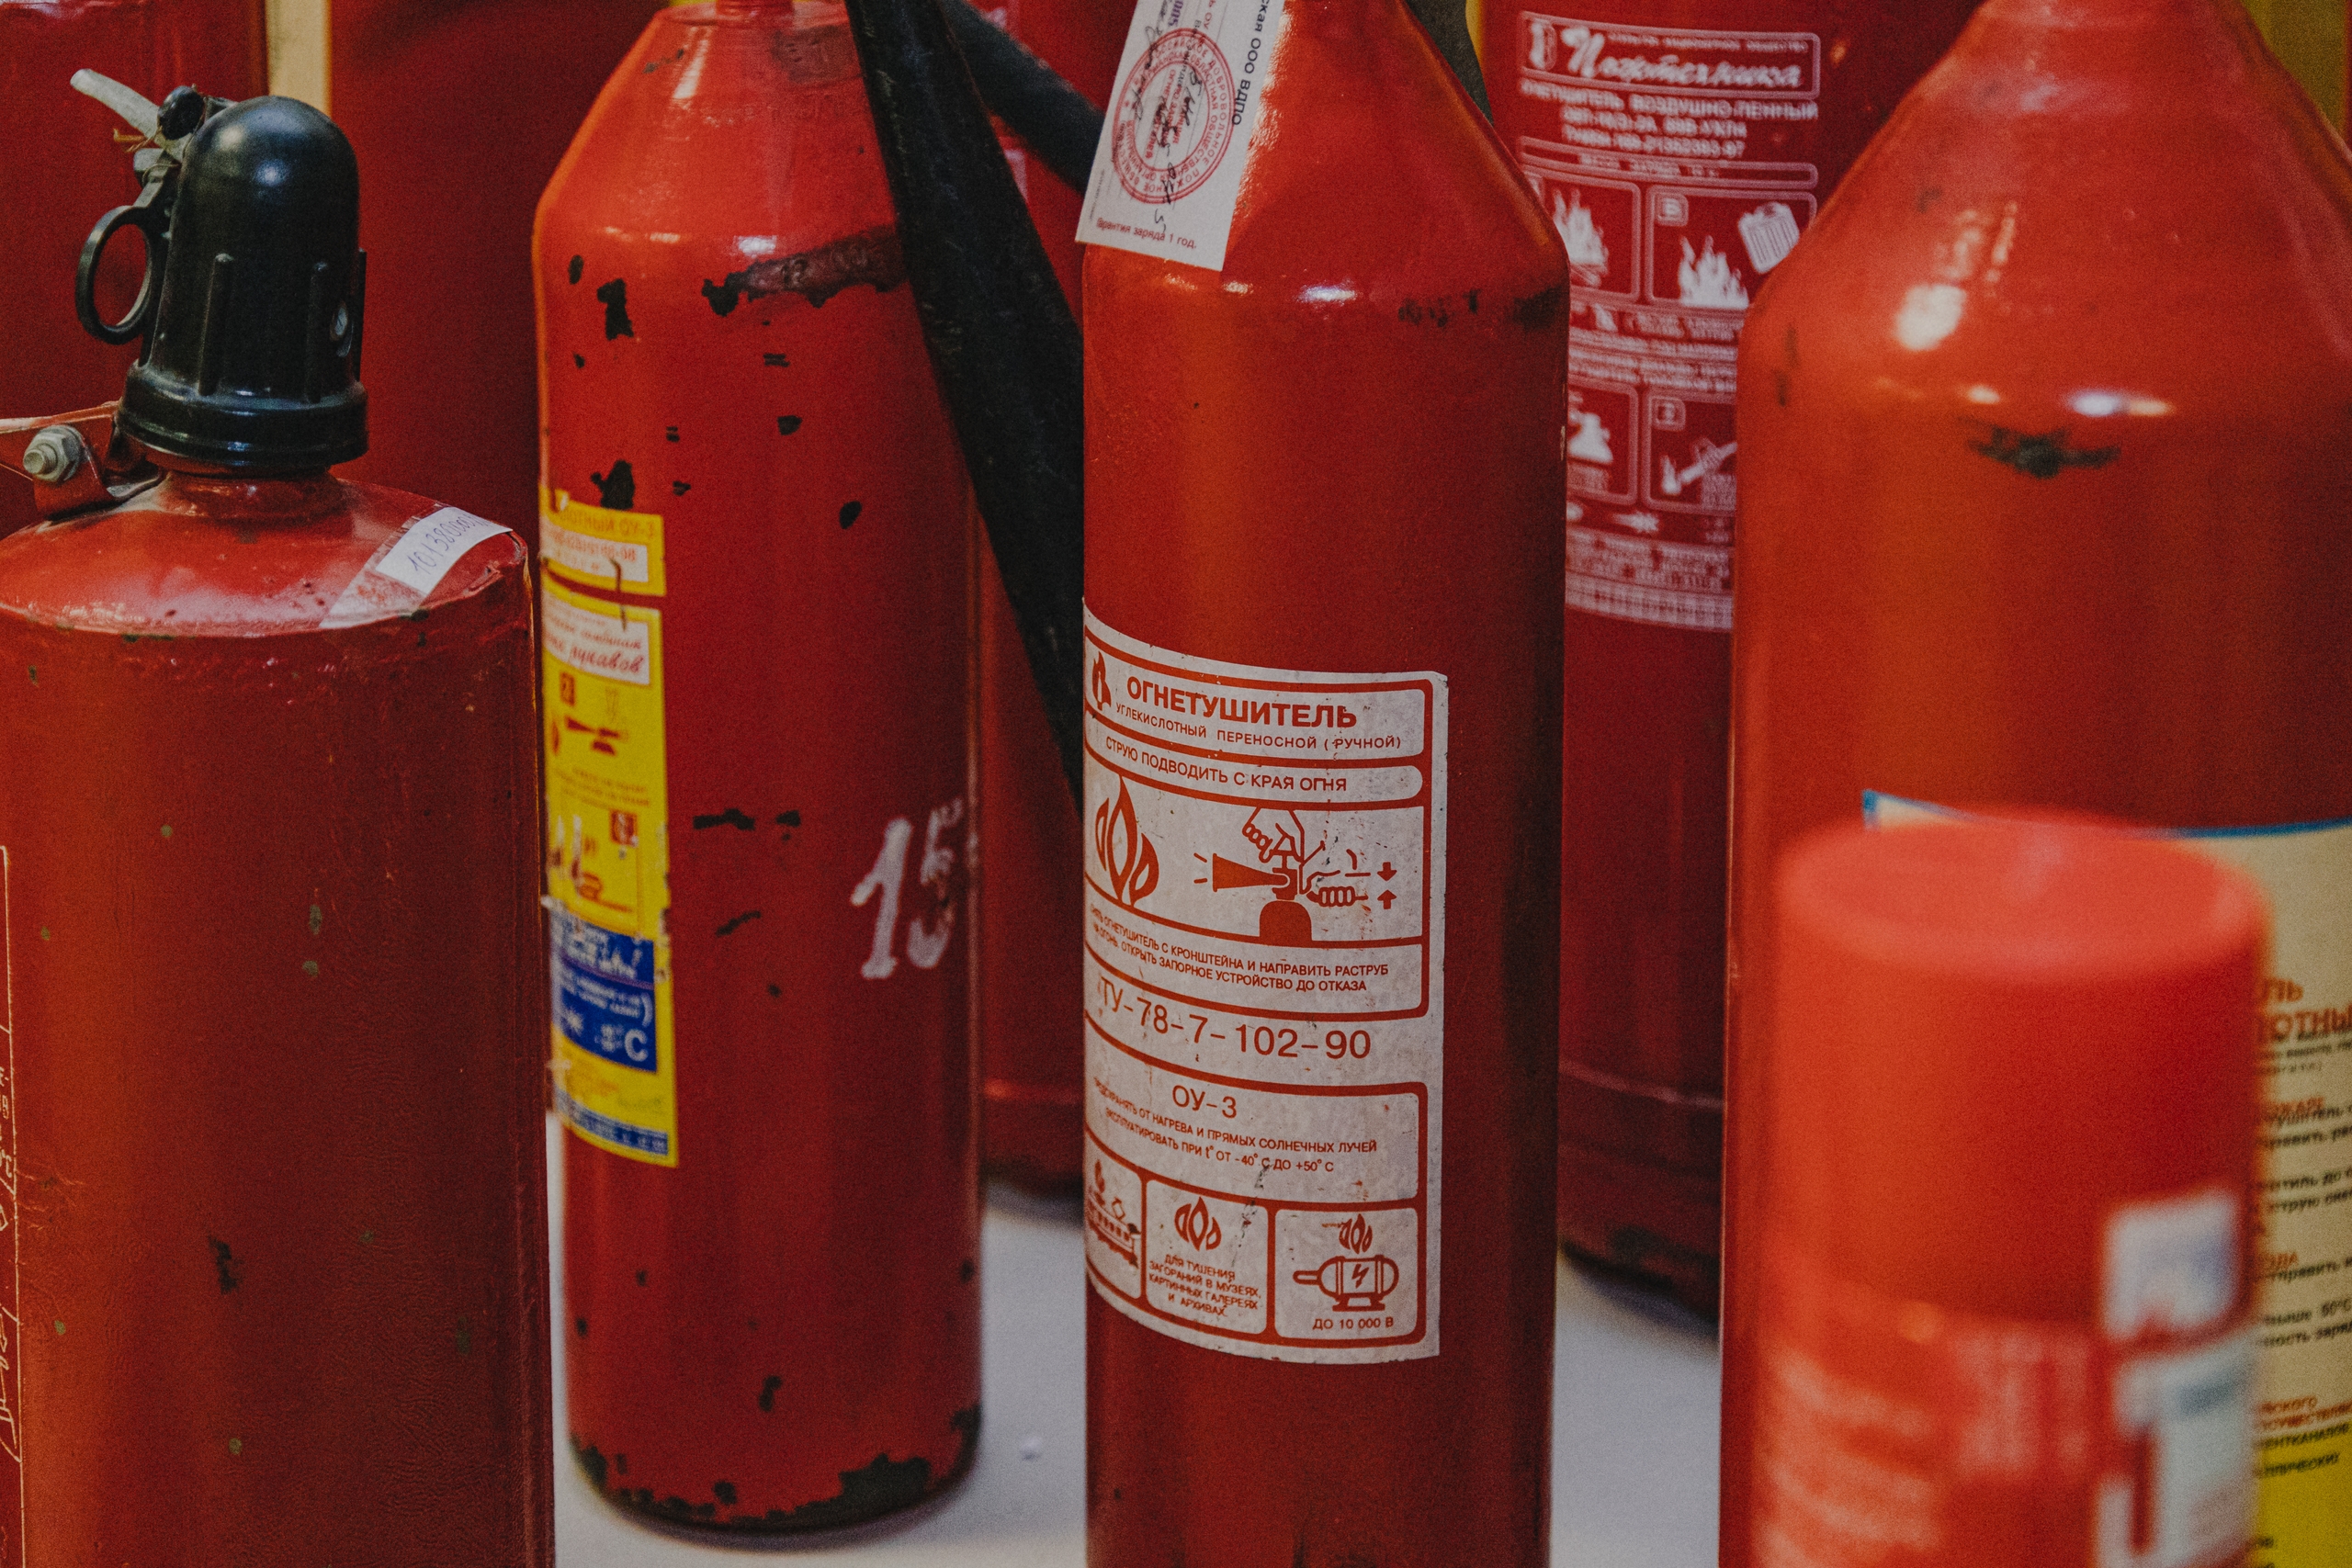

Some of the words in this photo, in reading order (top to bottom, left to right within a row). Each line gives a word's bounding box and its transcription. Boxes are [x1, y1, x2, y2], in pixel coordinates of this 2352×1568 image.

[1244, 38, 1261, 73] ООО
[1231, 79, 1250, 125] ВДПО
[1133, 226, 1166, 242] заряда
[1169, 232, 1174, 243] 1
[1176, 236, 1197, 250] год.
[1126, 675, 1358, 730] ОГНЕТУШИТЕЛЬ
[1115, 702, 1207, 739] УГЛЕКИСЛОТНЫЙ
[1217, 729, 1317, 750] ПЕРЕНОСНОЙ
[1105, 736, 1139, 763] СТРУЮ
[1141, 750, 1229, 784] ПОДВОДИТЬ
[1233, 772, 1246, 786] С
[1250, 773, 1295, 790] КРАЯ
[1299, 777, 1348, 792] ОГНЯ
[1103, 916, 1159, 951] ОГНЕТУШИТЕЛЬ
[1161, 942, 1169, 953] С
[1170, 945, 1244, 971] КРОНШТЕЙНА
[1247, 960, 1256, 971] И
[1260, 962, 1331, 976] НАПРАВИТЬ
[1335, 964, 1389, 976] РАСТРУБ
[1121, 941, 1157, 964] ОТКРЫТЬ
[1159, 956, 1213, 980] ЗАПОРНОЕ
[1216, 969, 1293, 990] УСТРОЙСТВО
[1296, 979, 1315, 992] ДО
[1318, 980, 1367, 991] ОТКАЗА
[1172, 1085, 1237, 1119] ОУ-3
[1139, 1108, 1150, 1119] ОТ
[1152, 1114, 1193, 1134] НАГРЕВА
[1196, 1127, 1204, 1138] И
[1207, 1129, 1256, 1147] ПРЯМЫХ
[1259, 1138, 1334, 1153] СОЛНЕЧНЫХ
[1338, 1139, 1377, 1153] ЛУЧЕЙ
[1182, 1142, 1202, 1156] ПРИ
[1216, 1151, 1231, 1162] ОТ
[1272, 1158, 1292, 1171] ДО
[1149, 1260, 1203, 1285] ЗАГОРАНИЙ
[1205, 1279, 1213, 1289] В
[1165, 1254, 1184, 1267] ДЛЯ
[1186, 1260, 1236, 1281] ТУШЕНИЯ
[1148, 1273, 1202, 1298] КАРТИННЫХ
[1205, 1292, 1259, 1310] ГАЛЕРЕЯХ
[1168, 1293, 1175, 1303] И
[1312, 1318, 1333, 1331] ДО
[1340, 1319, 1354, 1330] 10
[1358, 1317, 1381, 1329] 000
[1385, 1316, 1394, 1328] В
